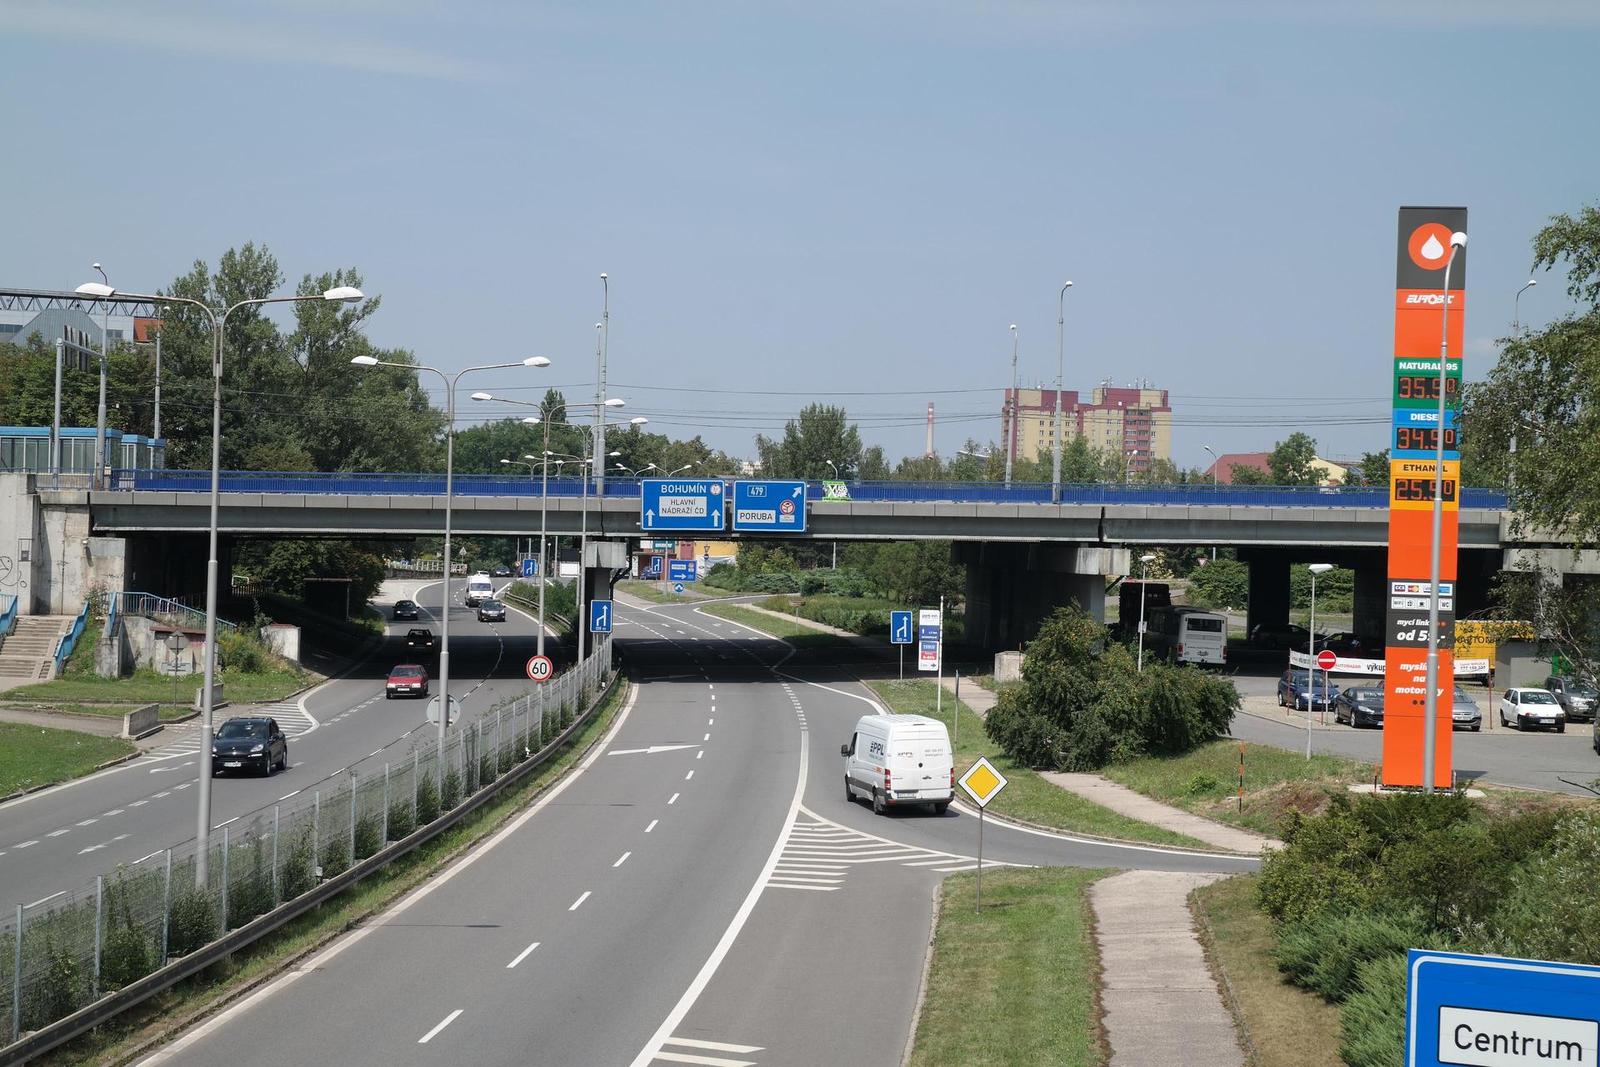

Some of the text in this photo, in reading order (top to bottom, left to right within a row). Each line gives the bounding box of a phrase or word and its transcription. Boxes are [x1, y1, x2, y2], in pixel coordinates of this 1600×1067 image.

[1410, 413, 1440, 421] DIESE
[1403, 464, 1448, 472] ETHANL
[661, 483, 707, 493] BOHUMÍN
[750, 486, 764, 495] 479
[740, 512, 773, 520] PORUBA
[1396, 630, 1416, 640] od
[532, 662, 547, 675] 60
[1454, 1023, 1582, 1061] Centrum
